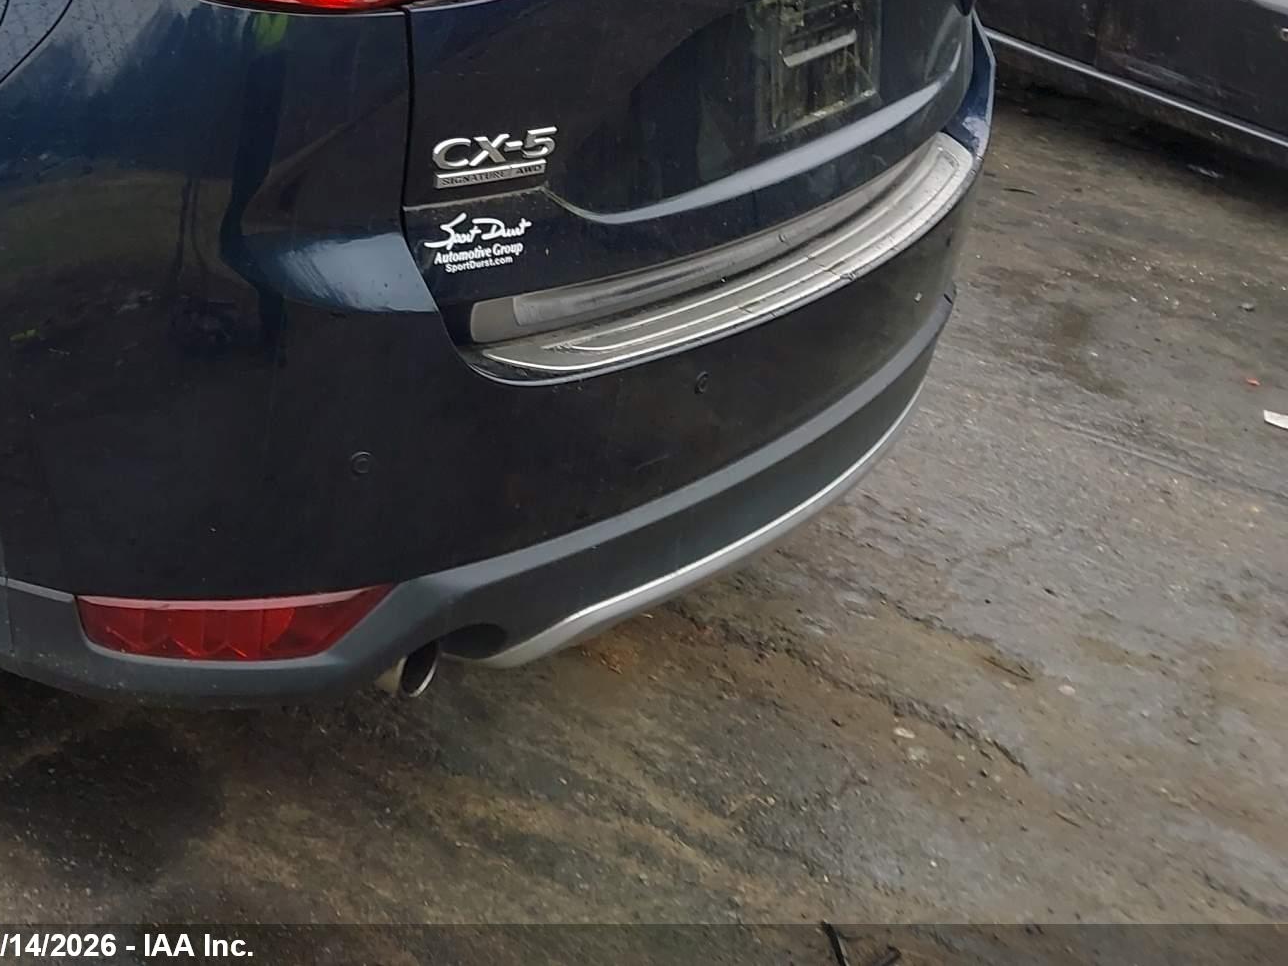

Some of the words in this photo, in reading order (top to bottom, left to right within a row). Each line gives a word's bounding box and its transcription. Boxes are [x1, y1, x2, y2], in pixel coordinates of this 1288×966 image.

[432, 126, 558, 170] CX-5
[515, 165, 543, 176] AWD
[424, 212, 482, 250] Sport
[434, 244, 492, 265] Automotive
[492, 242, 524, 256] Group
[445, 256, 513, 273] SportDurst.com
